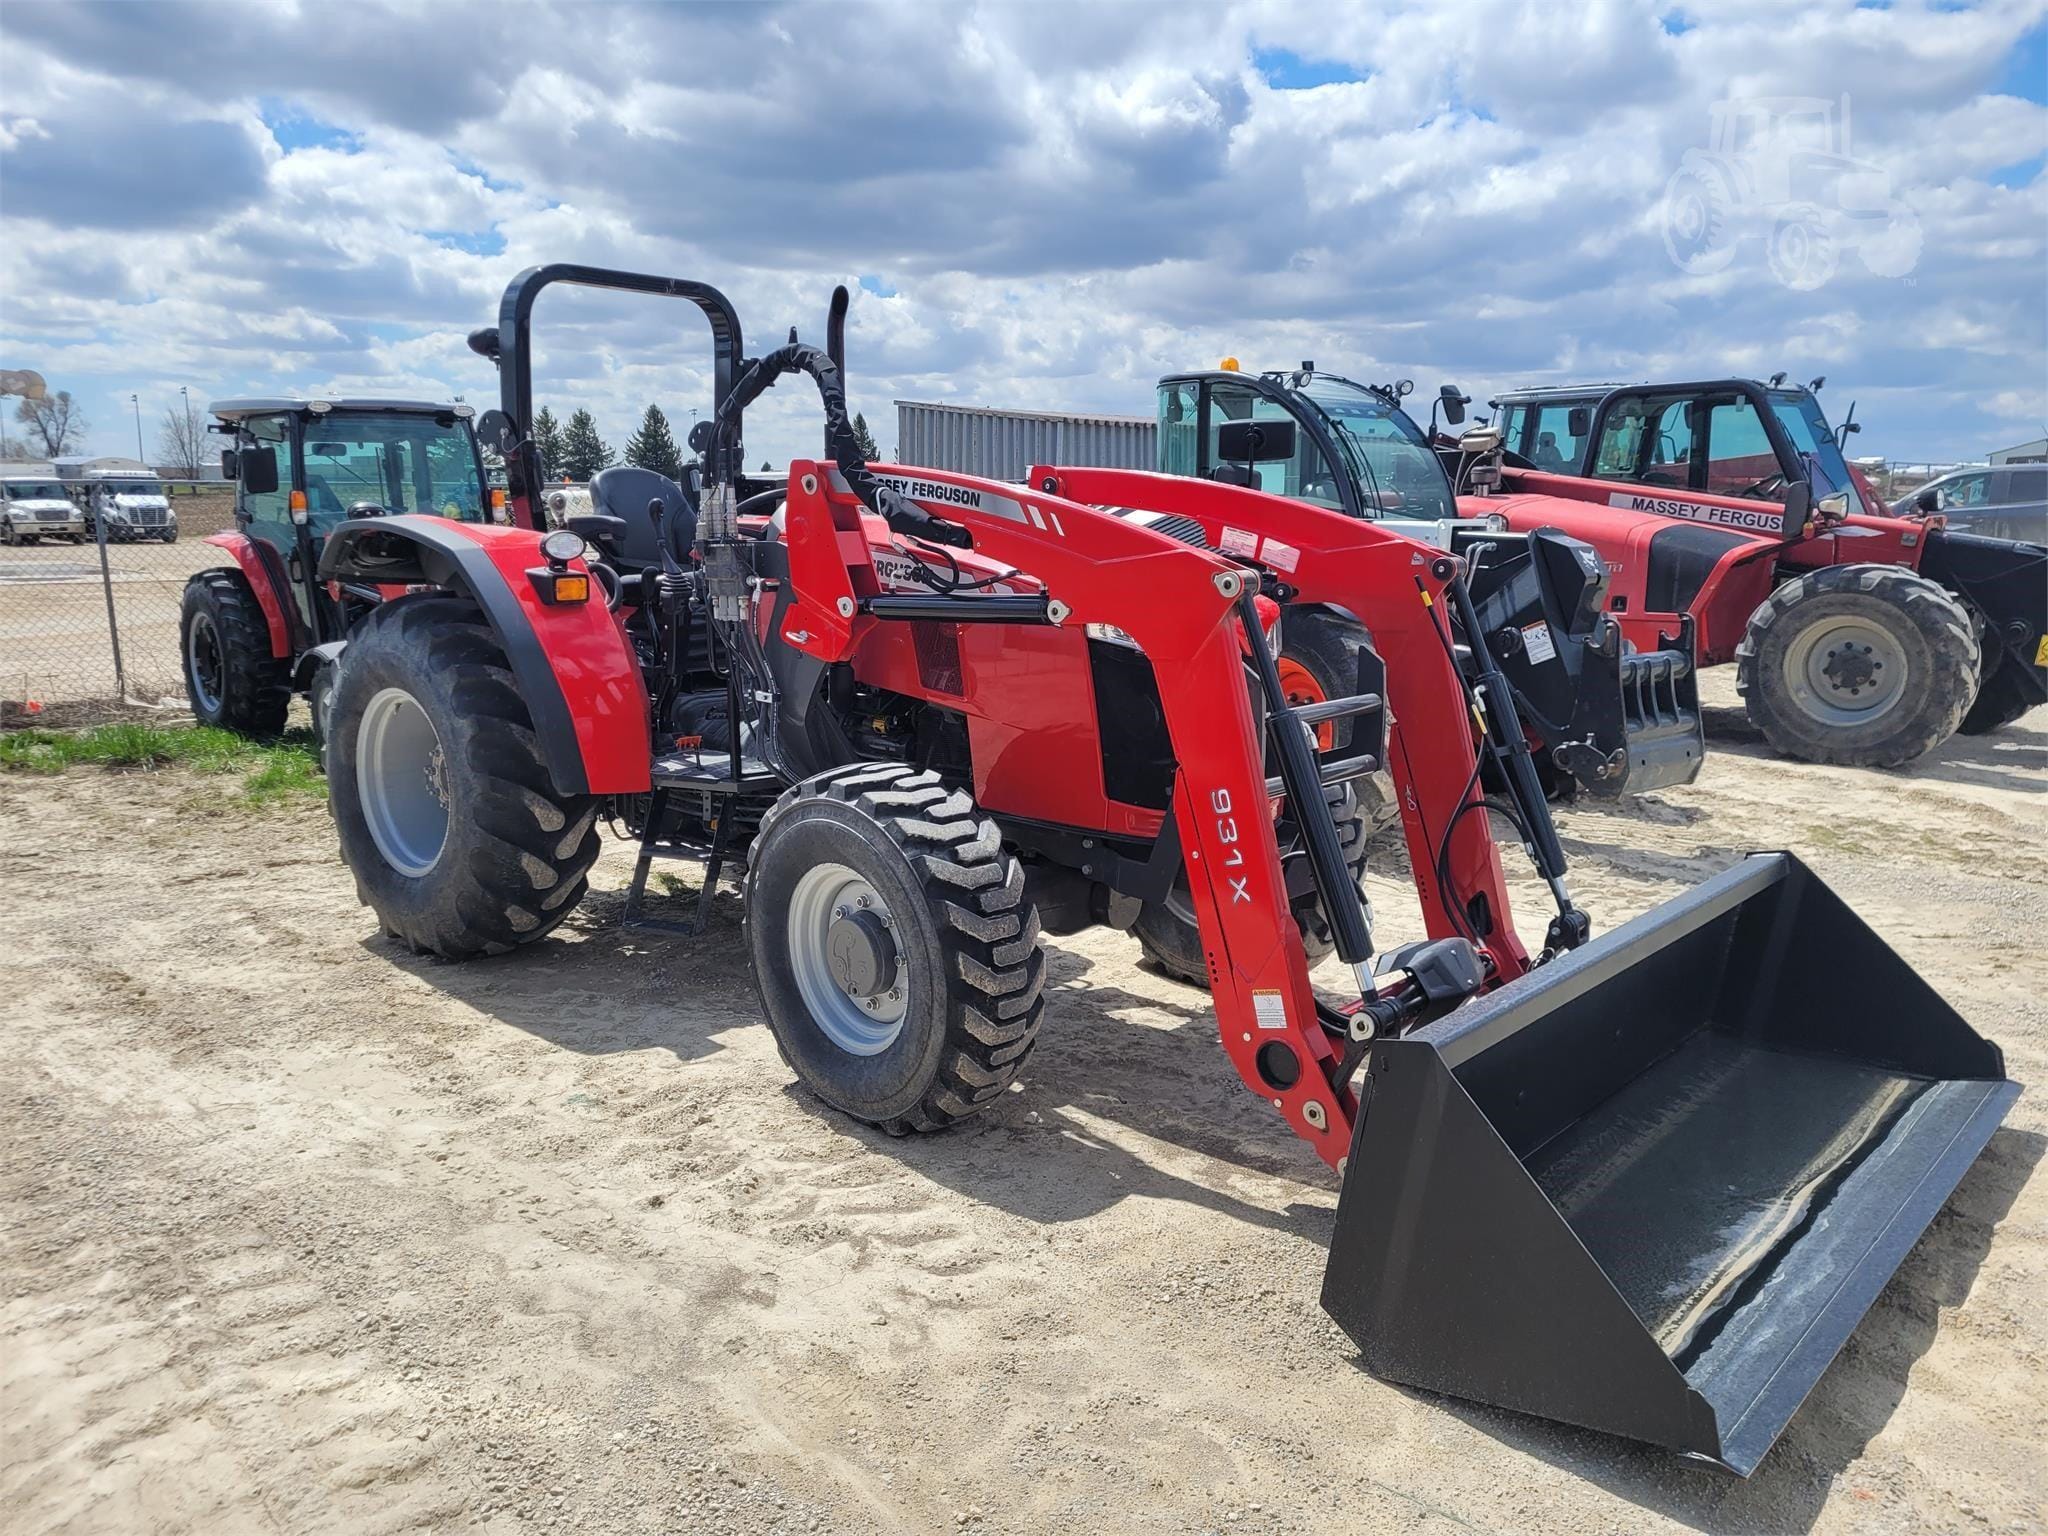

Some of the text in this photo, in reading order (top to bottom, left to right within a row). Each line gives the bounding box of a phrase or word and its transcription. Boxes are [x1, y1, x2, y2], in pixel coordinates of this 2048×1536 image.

[912, 481, 980, 507] FERGUSON
[1632, 497, 1784, 530] MASSEY FERGUS
